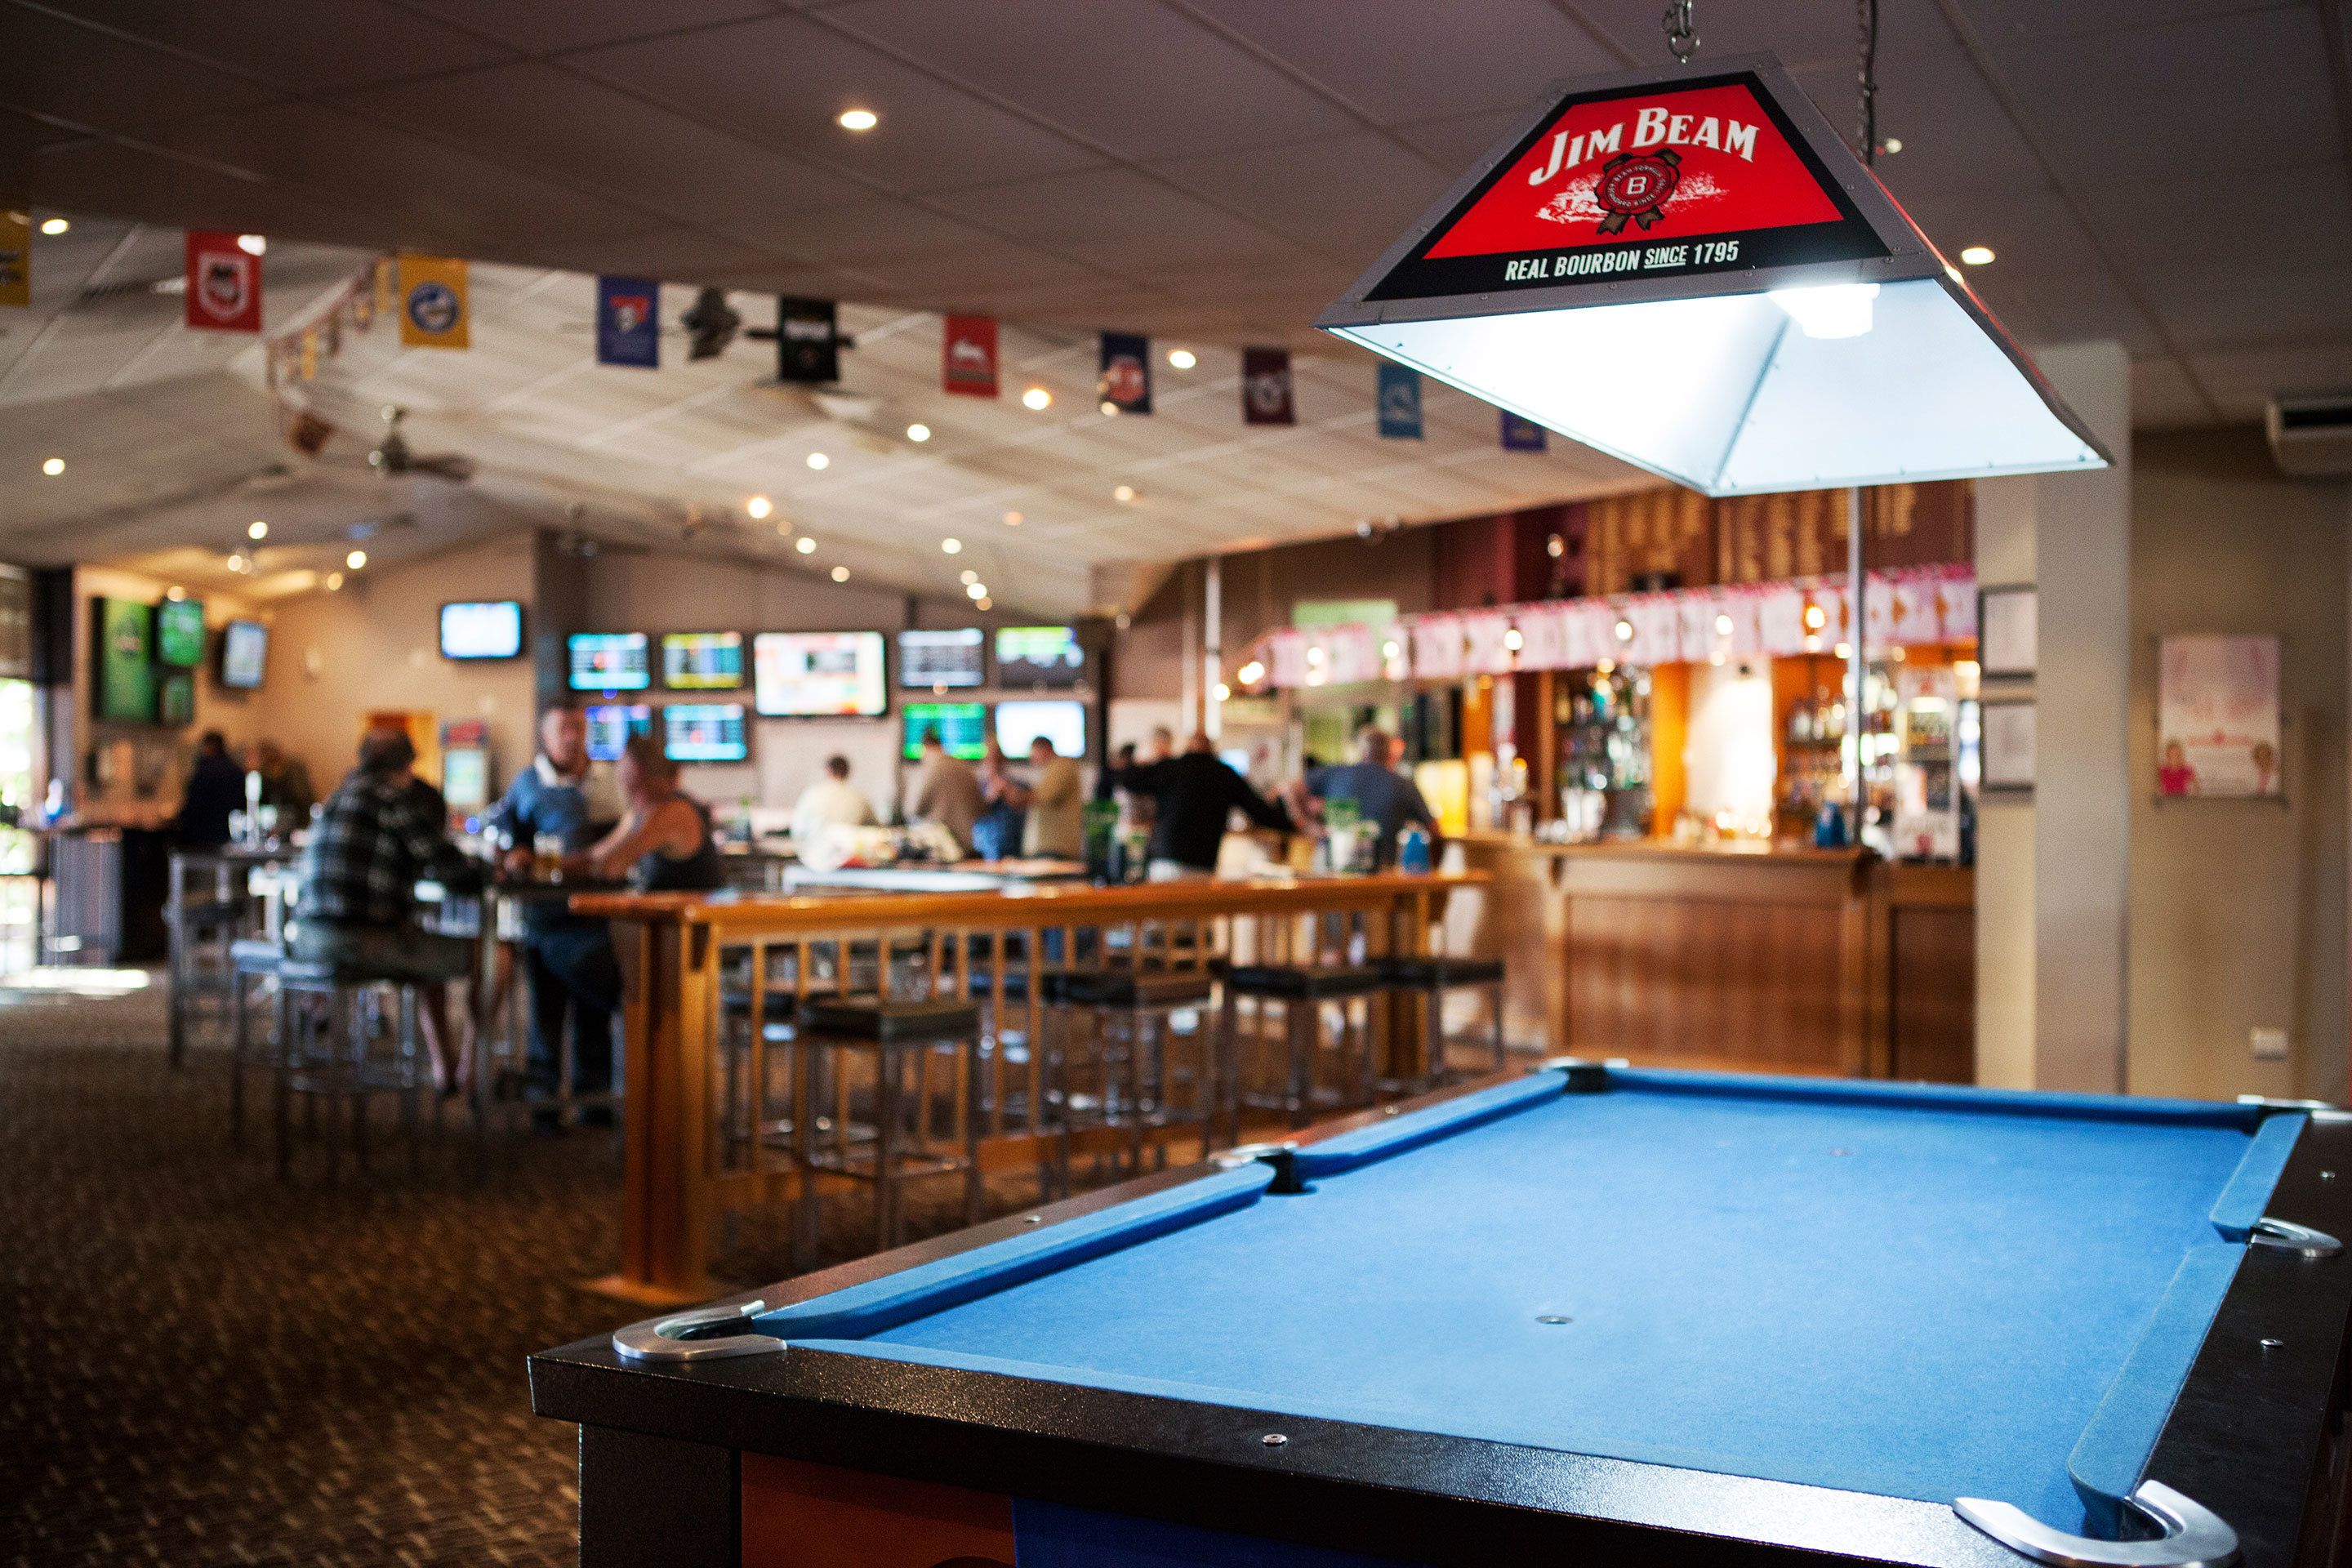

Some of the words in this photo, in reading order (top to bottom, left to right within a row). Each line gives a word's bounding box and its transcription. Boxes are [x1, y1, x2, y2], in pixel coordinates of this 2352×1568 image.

[1528, 122, 1627, 186] JIM
[1632, 107, 1760, 163] BEAM
[1626, 176, 1648, 195] B
[1504, 259, 1549, 282] REAL
[1553, 249, 1641, 278] BOURBON
[1643, 245, 1689, 267] SINCE
[1693, 241, 1740, 265] 1795
